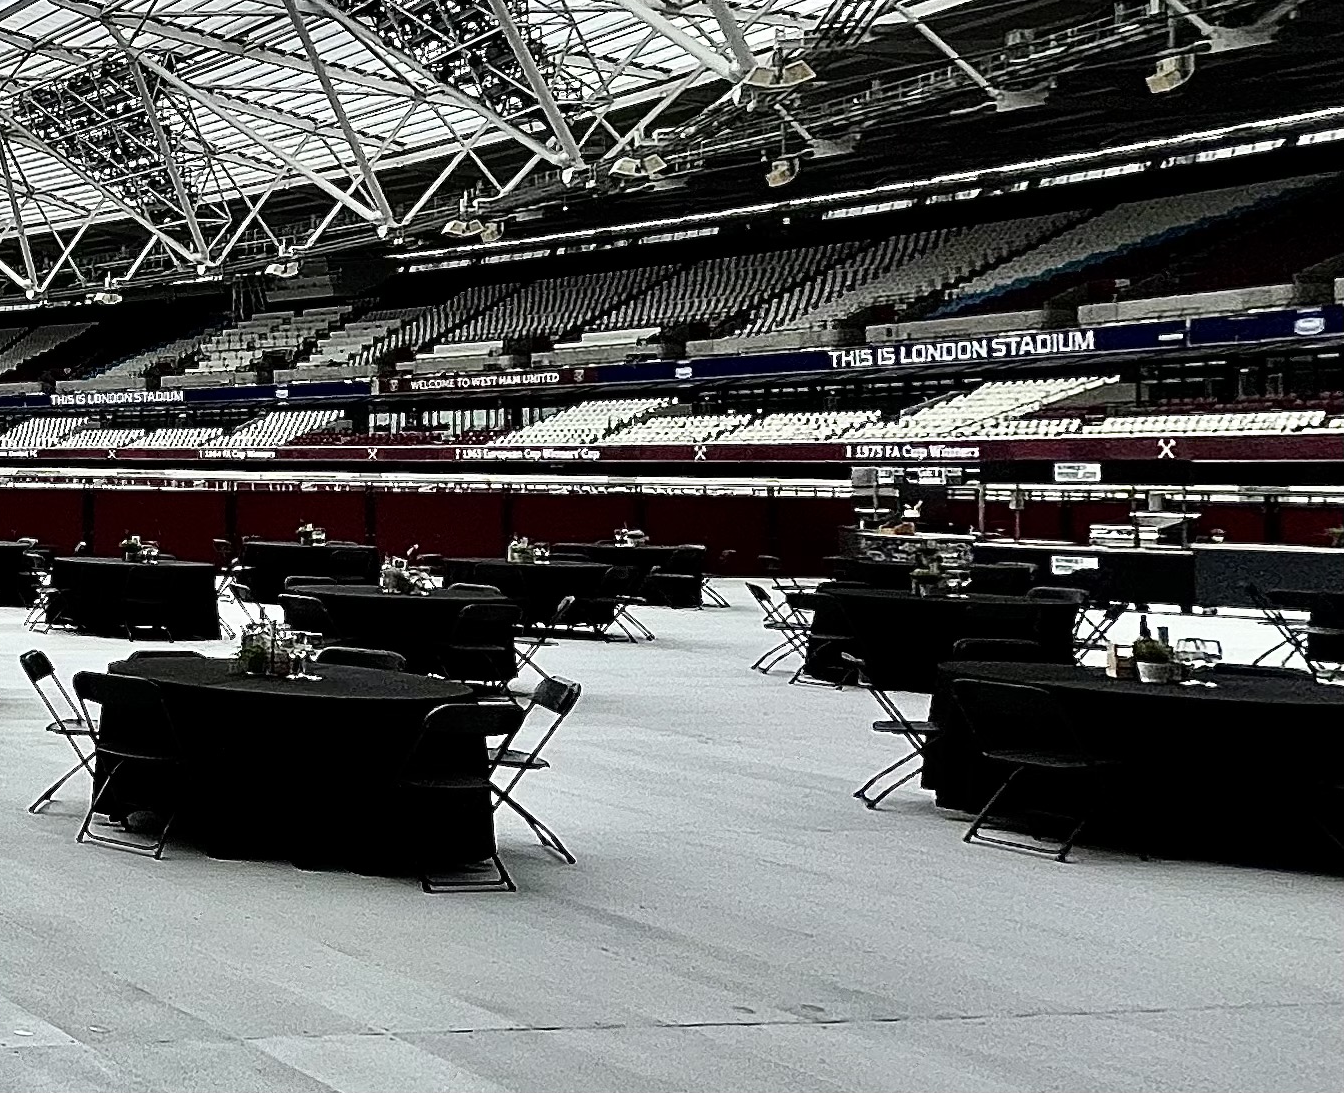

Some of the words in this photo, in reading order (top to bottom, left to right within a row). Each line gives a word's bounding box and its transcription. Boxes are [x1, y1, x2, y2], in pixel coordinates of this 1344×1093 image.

[828, 348, 872, 368] THIS
[877, 346, 896, 366] IS
[899, 339, 989, 364] LONDON
[990, 329, 1096, 358] STADIUM
[410, 378, 455, 390] WELCOME
[456, 377, 470, 388] TO
[470, 376, 498, 387] WEST
[499, 374, 522, 385] HAM
[522, 372, 560, 384] UNITED
[50, 394, 74, 405] THIS
[74, 393, 86, 405] IS
[88, 392, 133, 404] LONDON
[133, 390, 184, 403] STADIUM
[885, 446, 901, 458] FA
